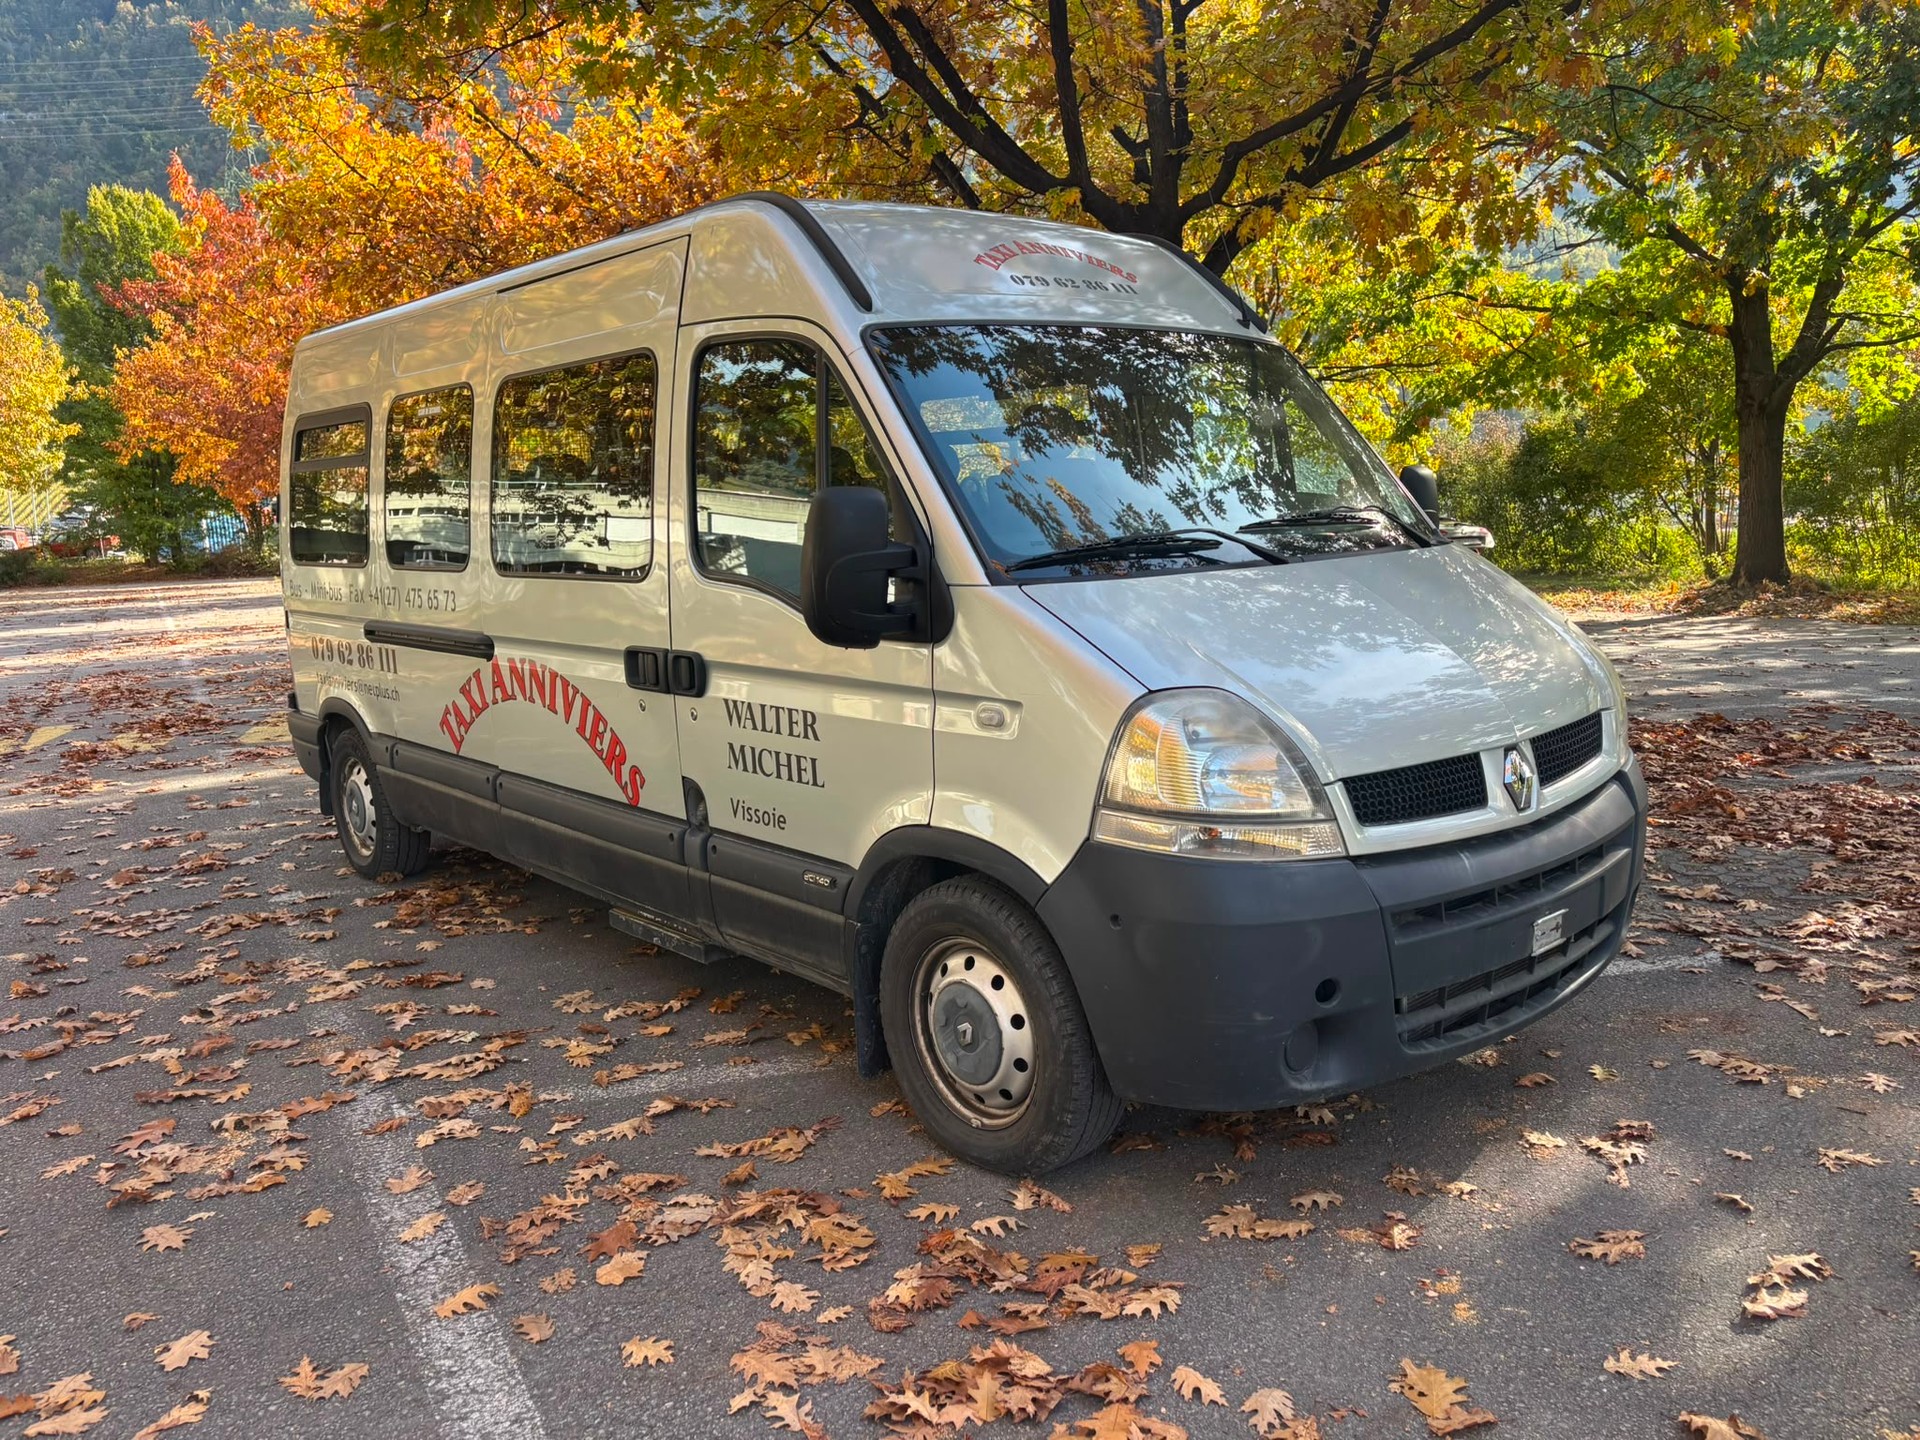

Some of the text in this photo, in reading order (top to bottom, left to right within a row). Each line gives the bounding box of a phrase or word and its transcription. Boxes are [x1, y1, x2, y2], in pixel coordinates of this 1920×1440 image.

[1010, 274, 1050, 287] 079
[1053, 278, 1080, 289] 62
[1082, 279, 1109, 292] 86
[289, 579, 302, 598] Bus
[349, 584, 365, 604] Fax
[369, 586, 401, 612] +41(27)
[405, 588, 423, 609] 475
[427, 589, 439, 611] 65
[443, 590, 457, 612] 73
[311, 637, 334, 662] 079
[337, 640, 354, 666] 62
[356, 643, 374, 670] 86
[722, 698, 821, 742] WALTER
[727, 742, 825, 788] MICHEL
[730, 797, 787, 830] Vissoie
